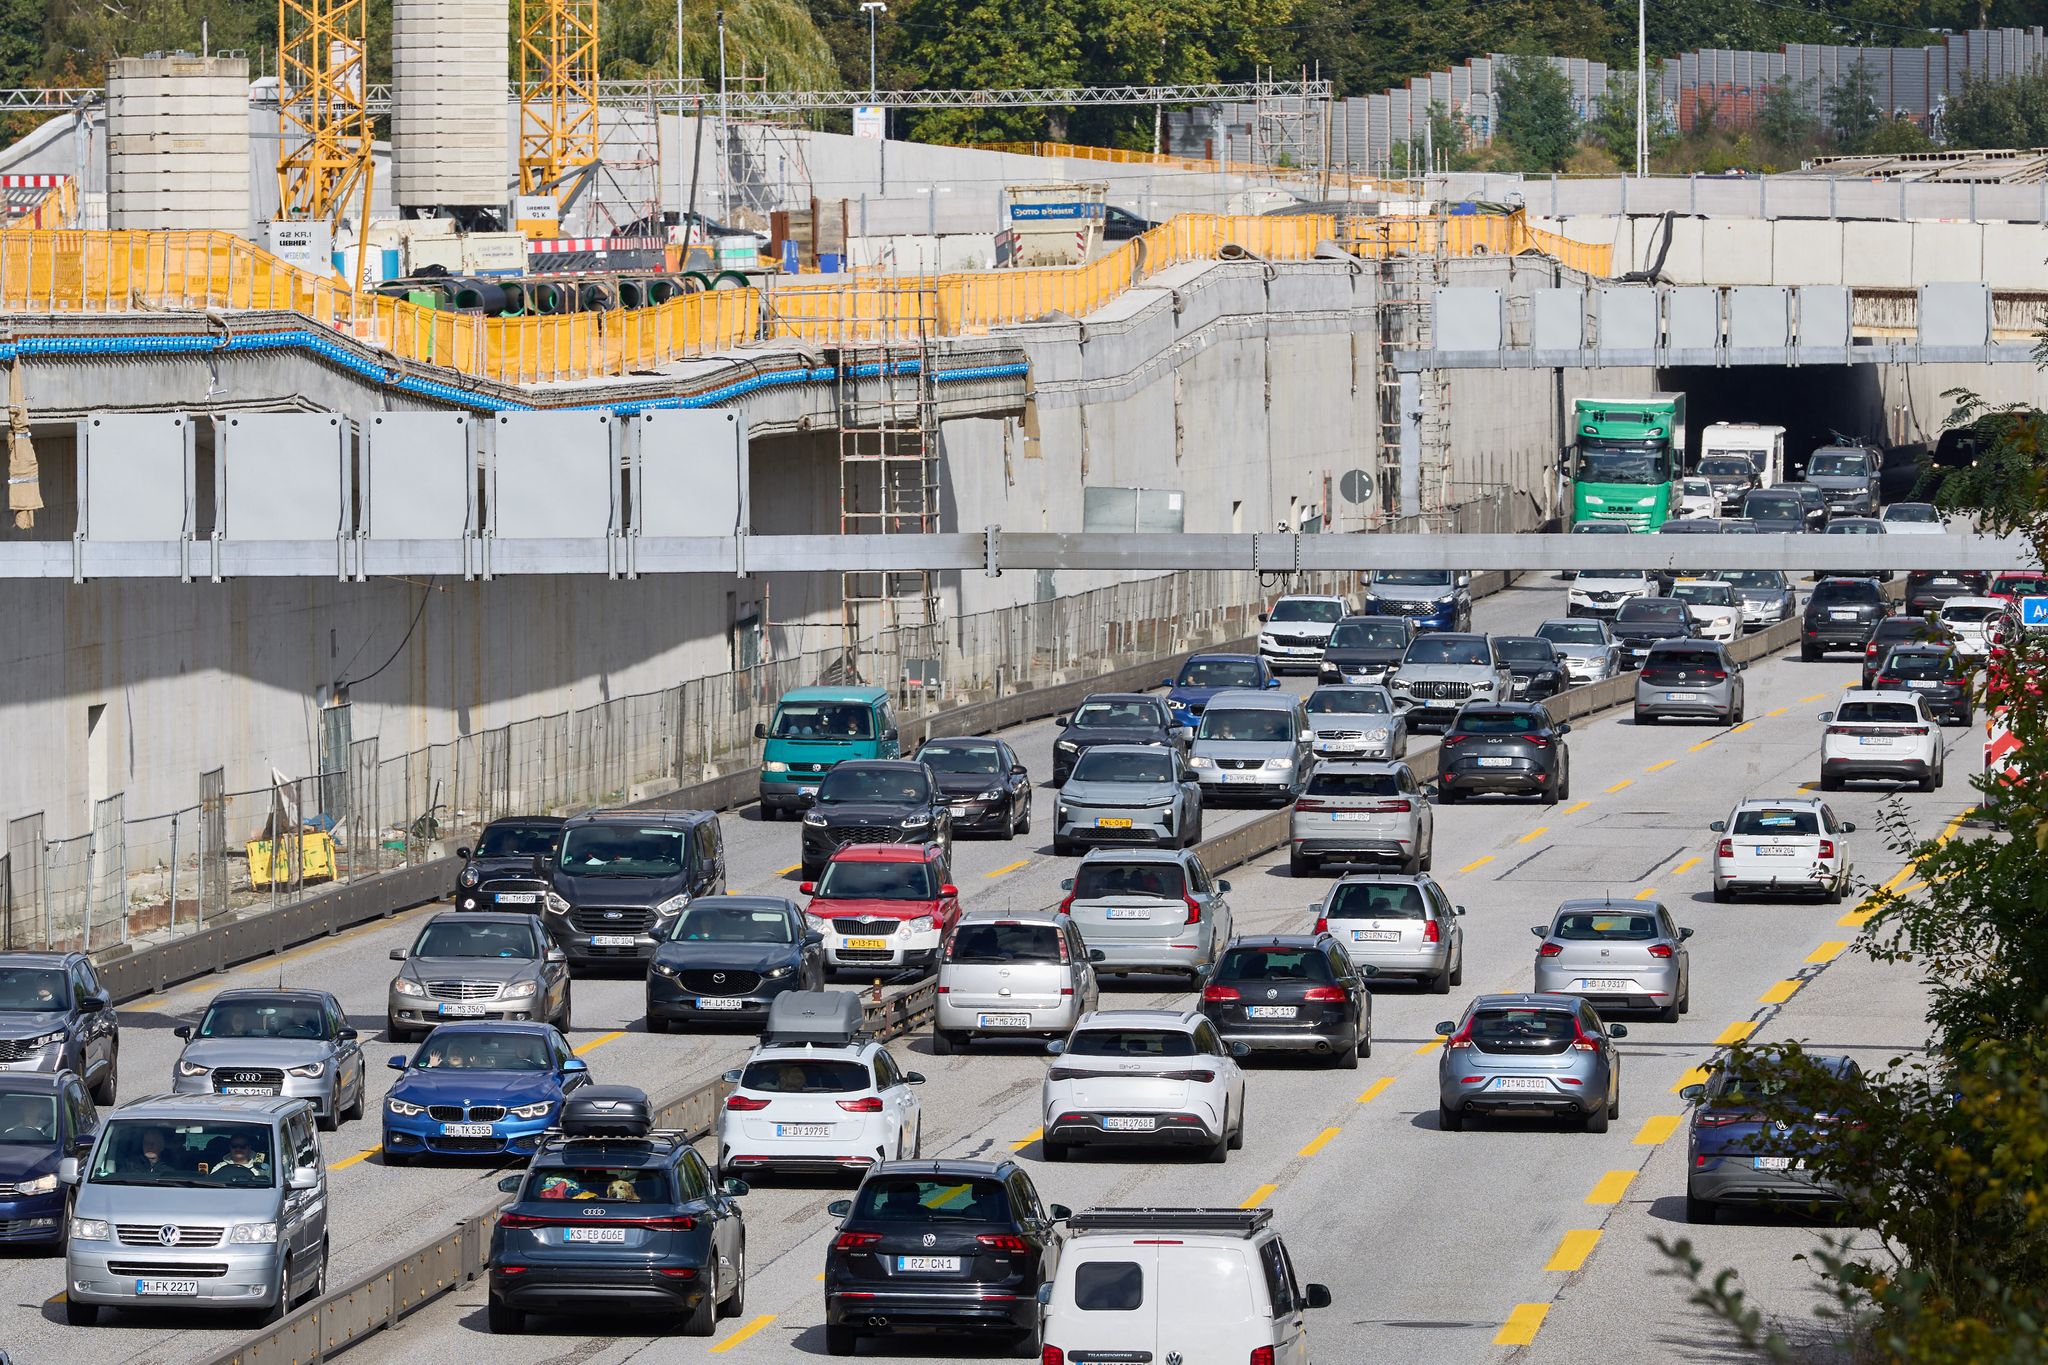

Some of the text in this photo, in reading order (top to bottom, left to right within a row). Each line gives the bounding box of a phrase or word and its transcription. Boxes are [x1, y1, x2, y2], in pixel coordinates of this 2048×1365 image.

[279, 231, 292, 239] 42
[498, 895, 507, 903] HH
[1358, 931, 1369, 939] BS
[1383, 931, 1397, 940] 437
[851, 939, 881, 947] V-13-FTL
[701, 999, 741, 1007] HH LM 516
[444, 1006, 484, 1014] HH MS 3562
[1254, 1007, 1295, 1016] PE JK 119
[985, 1017, 1027, 1026] HH MG 2716
[1501, 1079, 1511, 1088] PI
[1526, 1080, 1545, 1089] 3101
[1108, 1118, 1118, 1127] GG
[1129, 1119, 1153, 1127] 2768E
[471, 1127, 492, 1135] 5355
[793, 1126, 803, 1134] DY
[804, 1126, 829, 1135] 1979E
[570, 1230, 623, 1240] KS EB 606E
[911, 1258, 953, 1268] RZ CN 1
[143, 1281, 196, 1292] H FK 2217
